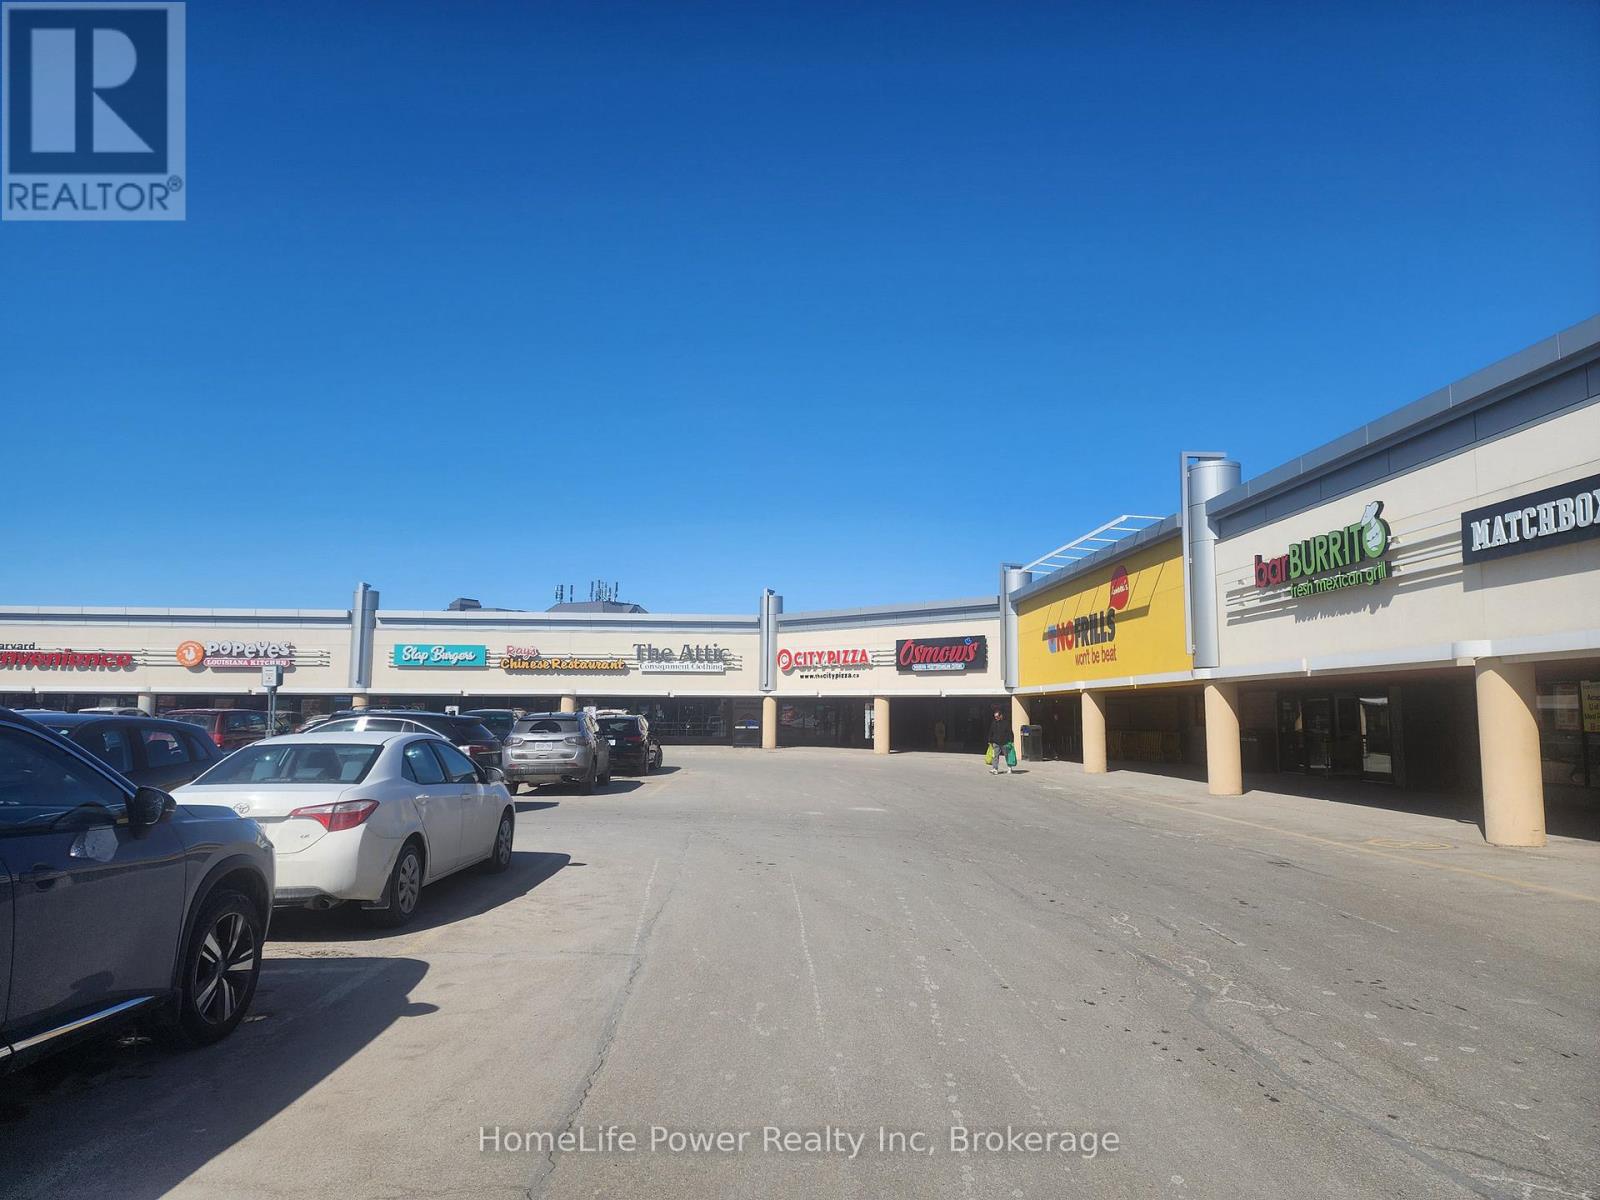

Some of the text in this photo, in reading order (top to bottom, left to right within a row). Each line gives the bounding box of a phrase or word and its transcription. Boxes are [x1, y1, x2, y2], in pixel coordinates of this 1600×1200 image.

[1315, 570, 1363, 593] mexican
[1366, 561, 1387, 586] grill
[402, 646, 476, 666] Slap Burgers
[633, 643, 732, 662] The Attic
[794, 648, 869, 667] CITY PIZZA
[1092, 647, 1100, 664] be
[1101, 644, 1117, 662] beat
[500, 657, 625, 670] Chinese Restaurant
[691, 662, 724, 671] Clothing
